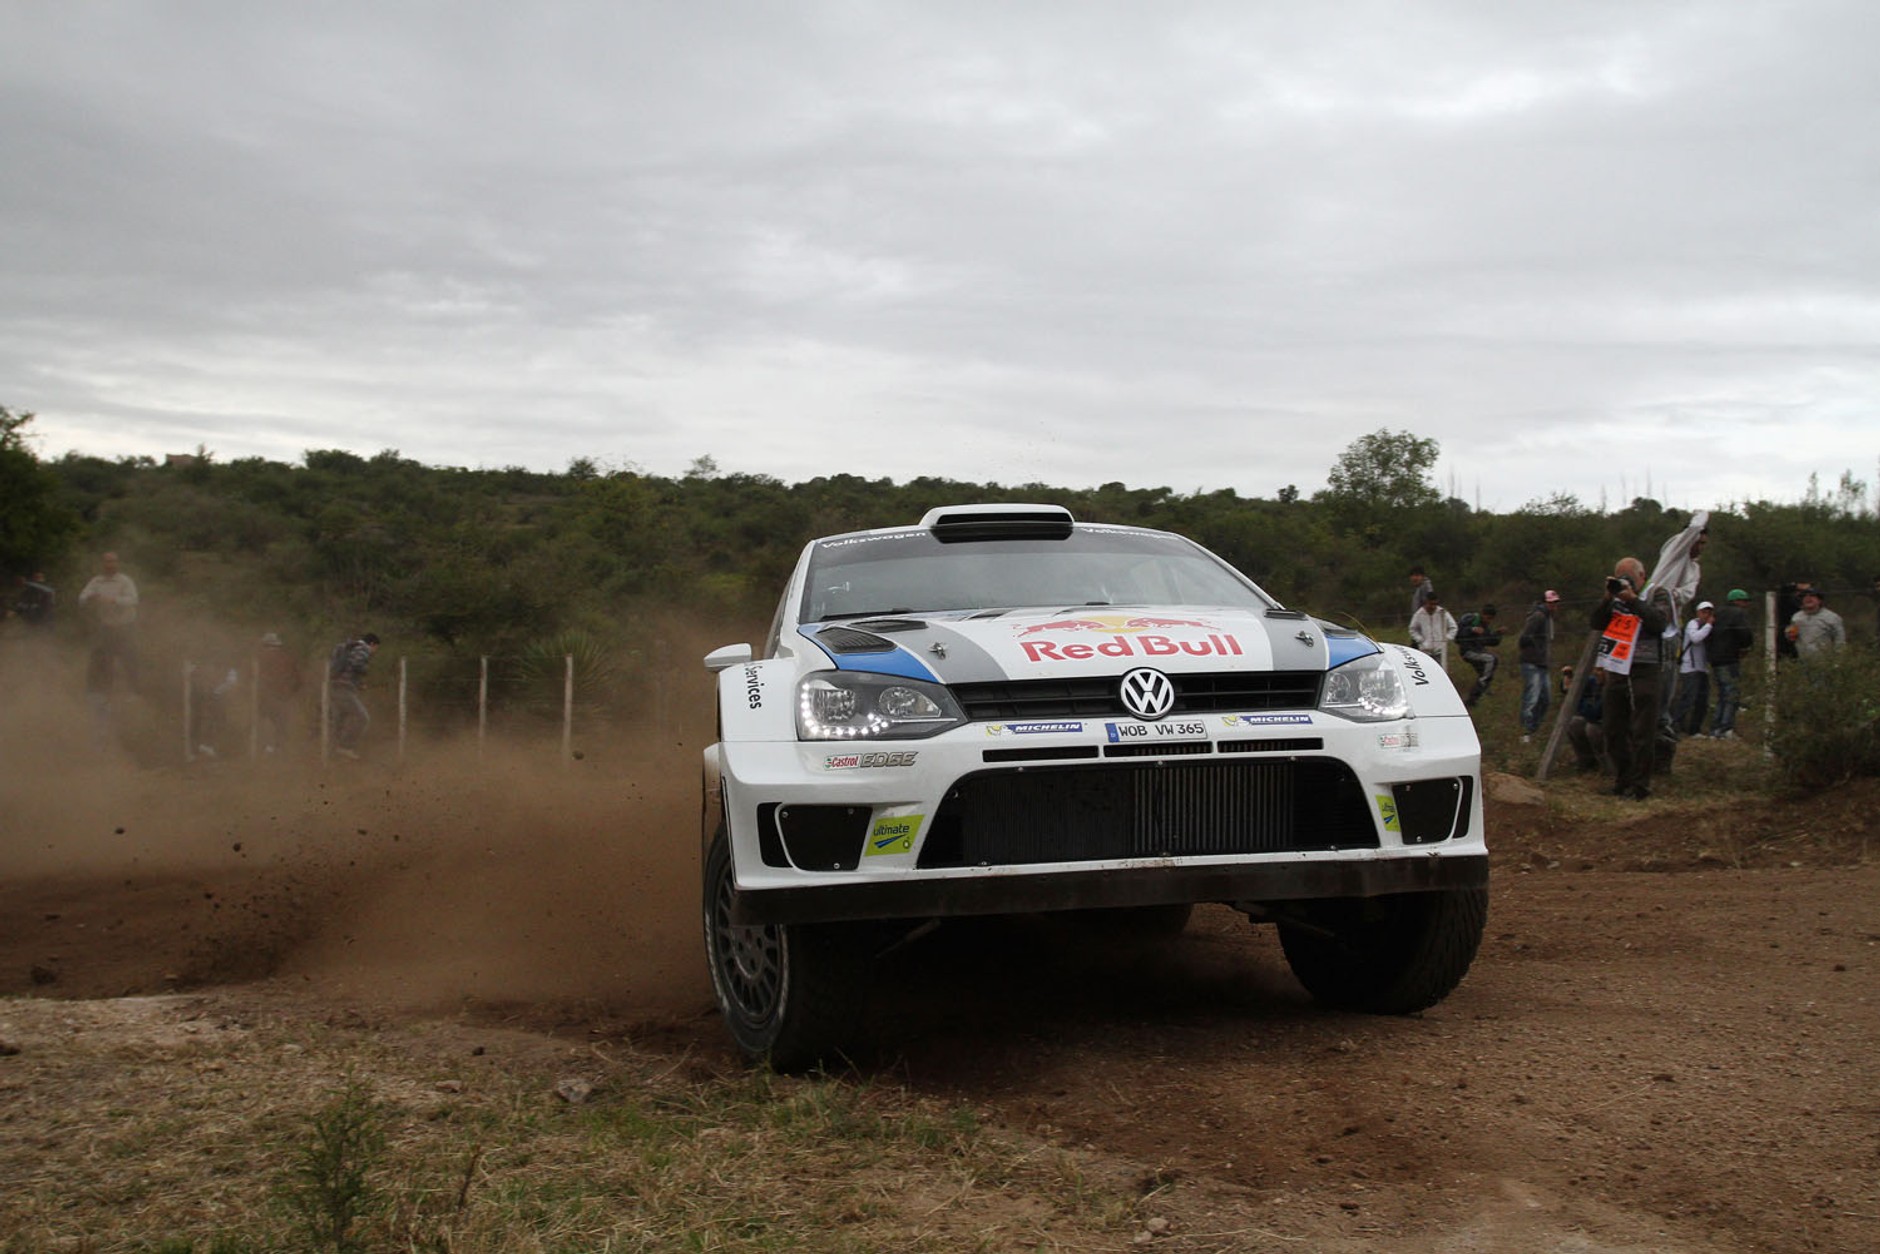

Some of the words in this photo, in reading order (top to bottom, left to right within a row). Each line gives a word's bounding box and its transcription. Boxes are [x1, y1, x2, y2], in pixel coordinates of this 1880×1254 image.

[822, 532, 926, 549] Volkswagen
[1020, 635, 1135, 662] Red
[1136, 634, 1244, 656] Bull
[1250, 715, 1310, 723] MICHELIN
[1015, 723, 1080, 732] MICHELIN
[1118, 725, 1148, 737] WOB
[1155, 724, 1174, 736] VW
[1176, 723, 1205, 735] 365
[831, 755, 859, 768] Castrol
[860, 751, 919, 768] EDGE
[873, 823, 910, 836] ultimate
